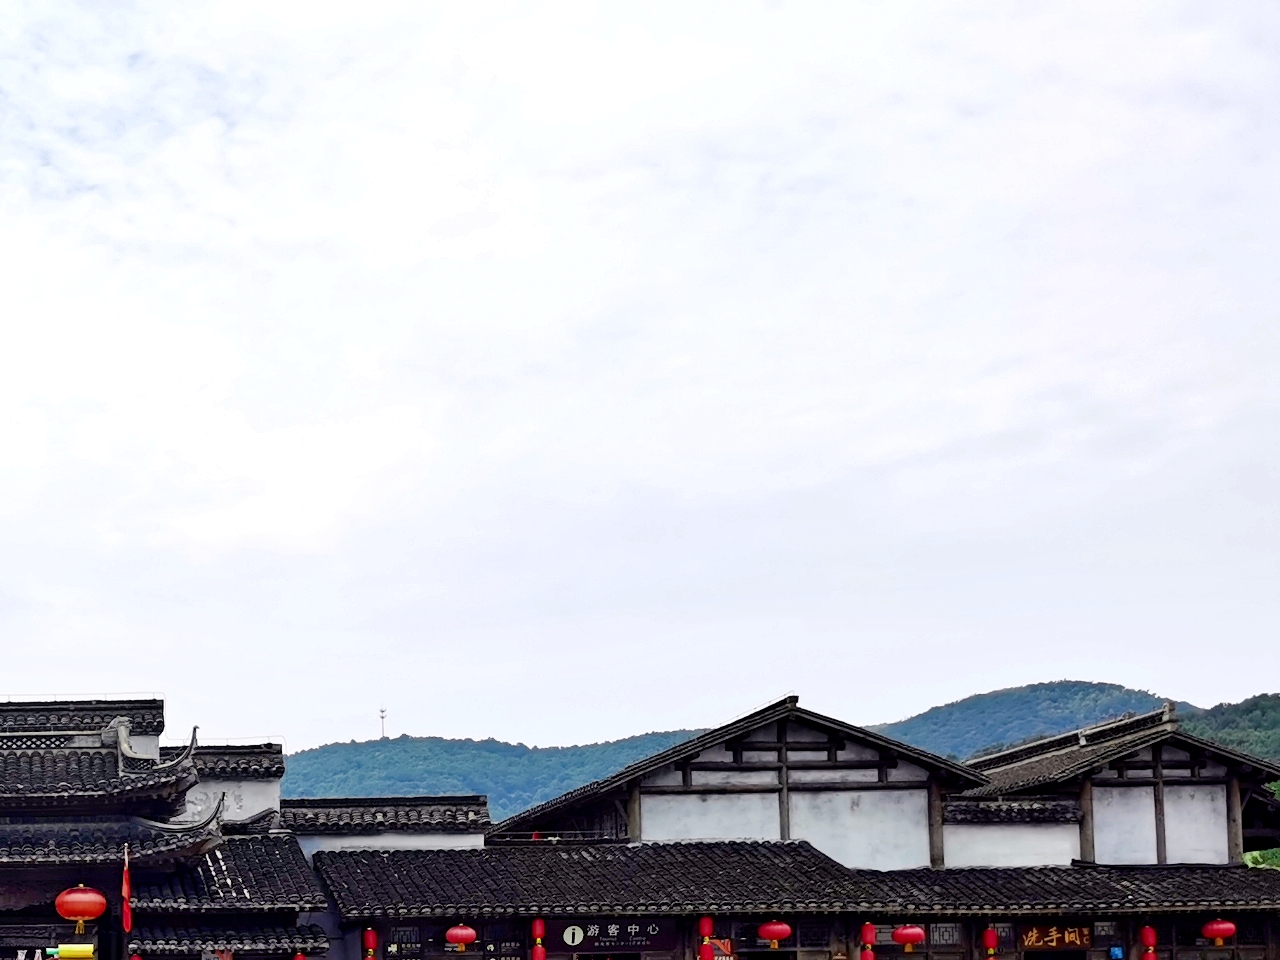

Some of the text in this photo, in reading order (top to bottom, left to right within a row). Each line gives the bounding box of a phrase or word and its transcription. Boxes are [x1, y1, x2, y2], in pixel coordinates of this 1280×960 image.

[587, 924, 659, 936] 游客中心
[1023, 926, 1081, 946] 洗手间
